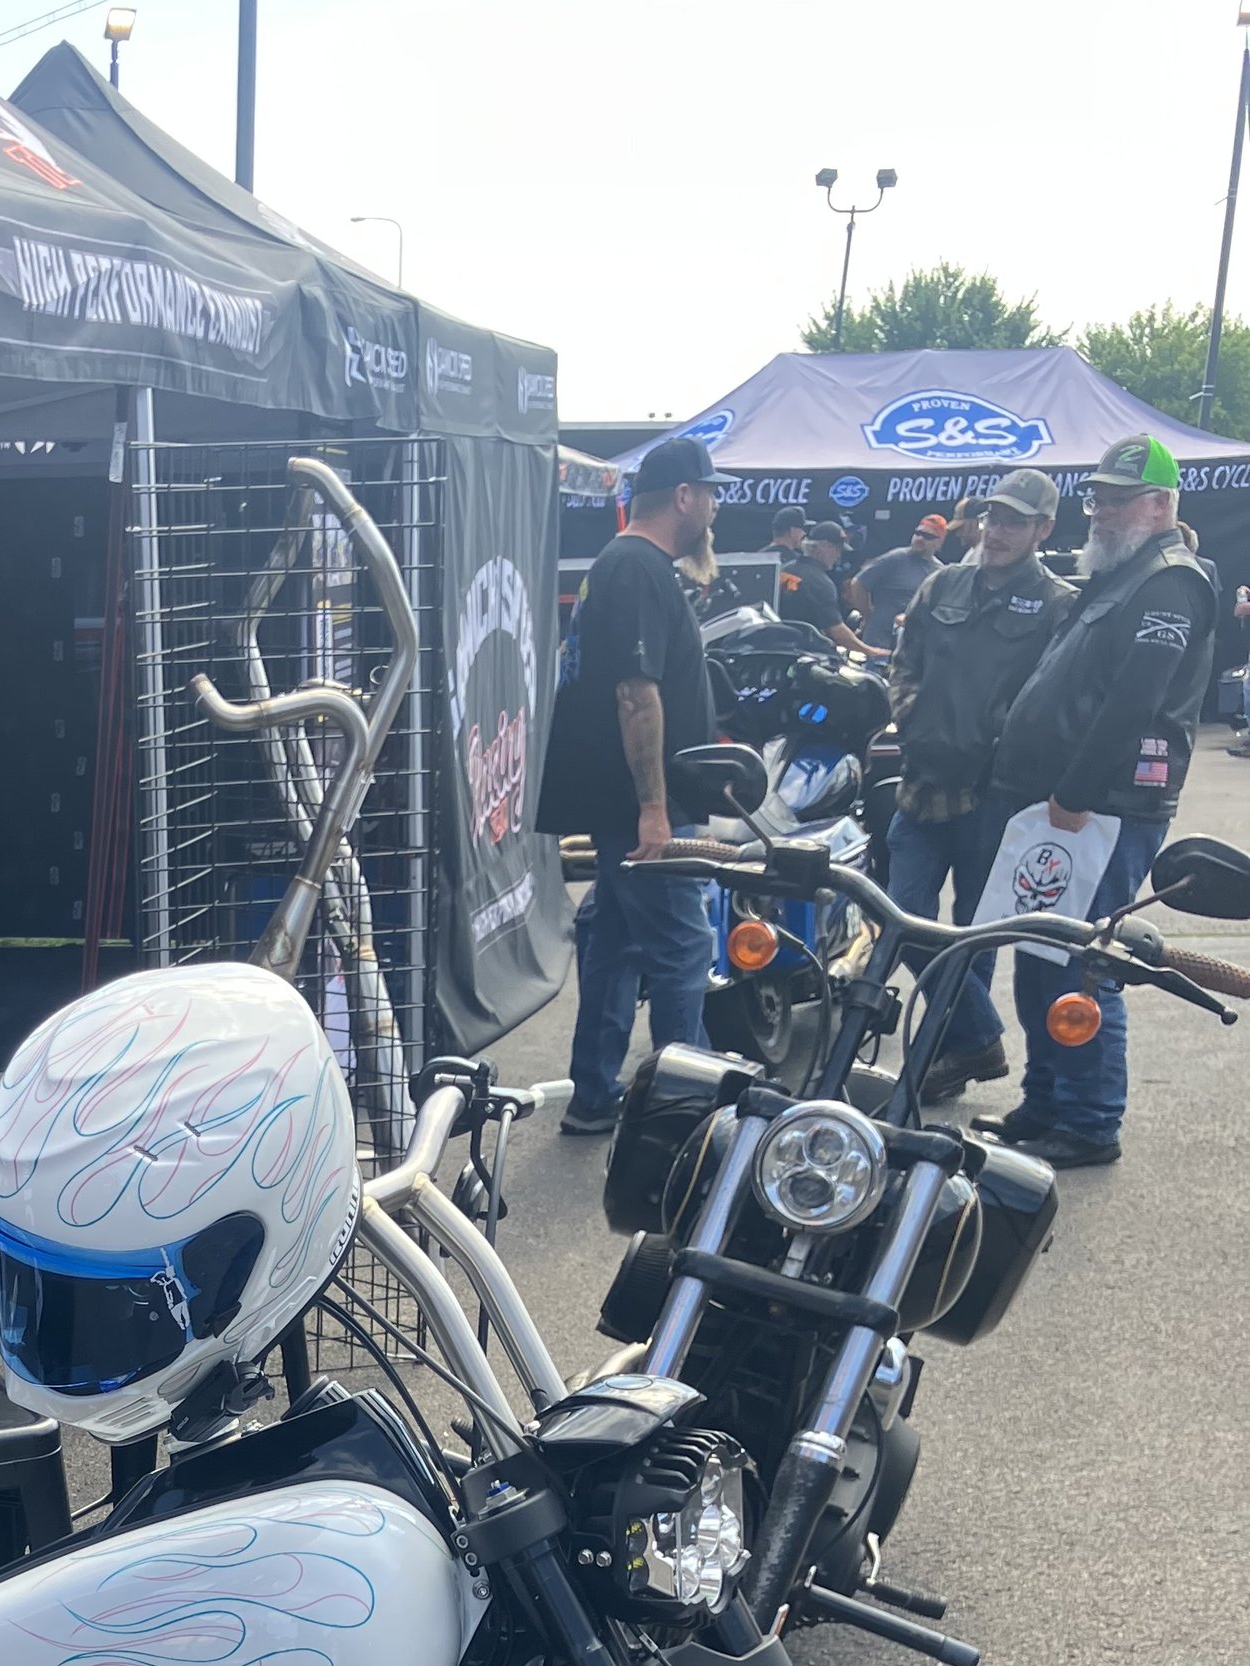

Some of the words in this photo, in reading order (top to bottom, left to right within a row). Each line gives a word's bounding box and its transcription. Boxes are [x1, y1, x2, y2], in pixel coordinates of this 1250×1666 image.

[912, 398, 972, 413] PROVEN
[895, 415, 1018, 449] S&S
[755, 478, 813, 504] CYCLE
[887, 474, 964, 502] PROVEN
